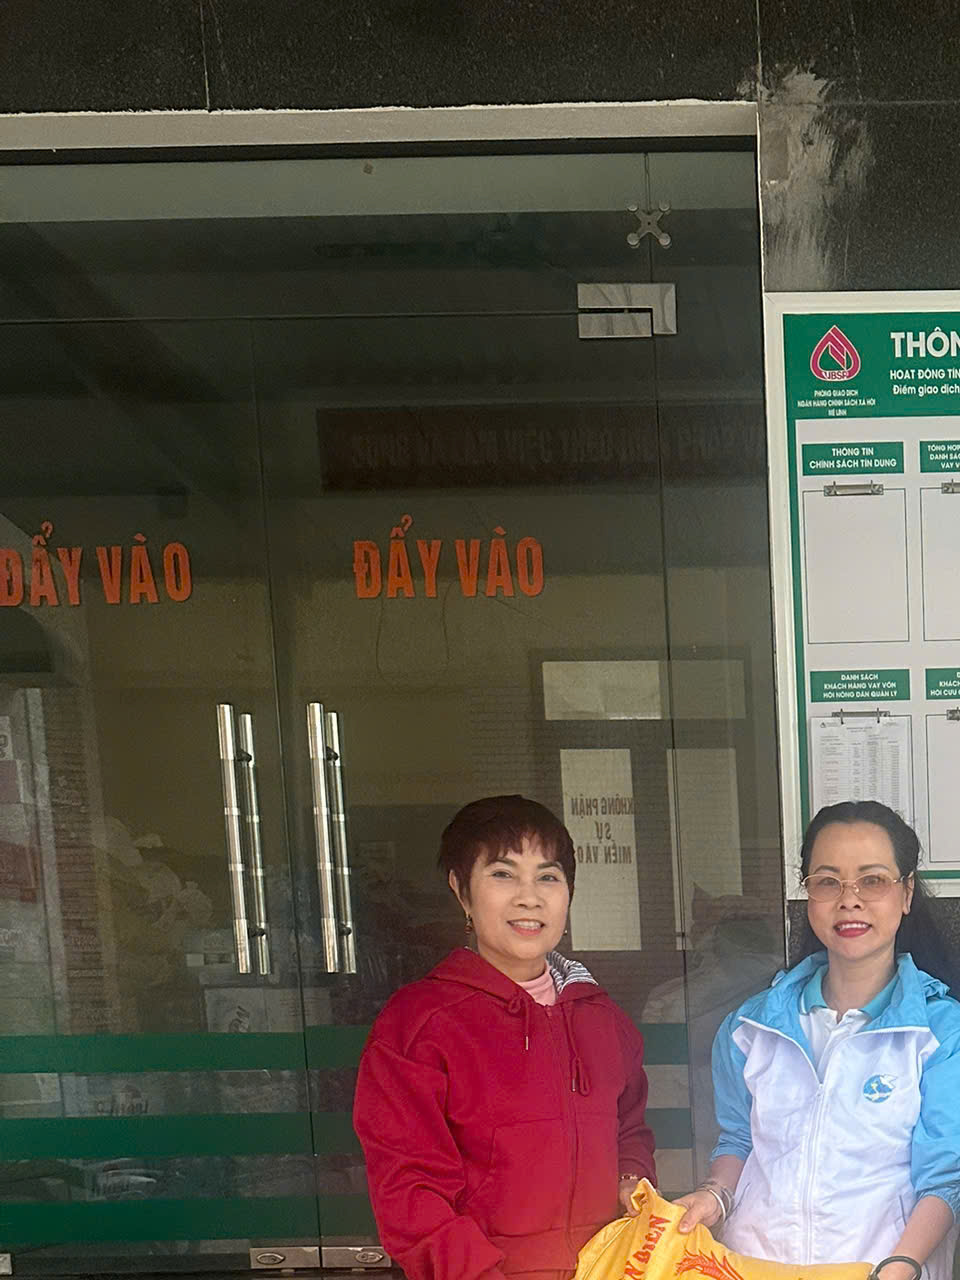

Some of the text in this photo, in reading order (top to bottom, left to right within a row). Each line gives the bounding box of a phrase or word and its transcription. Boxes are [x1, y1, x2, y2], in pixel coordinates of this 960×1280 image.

[918, 384, 939, 397] giao
[862, 447, 873, 456] TIN
[836, 458, 859, 468] SÁCH
[0, 520, 193, 606] ĐẨY VÀO
[352, 514, 545, 599] ĐẨY VÀO
